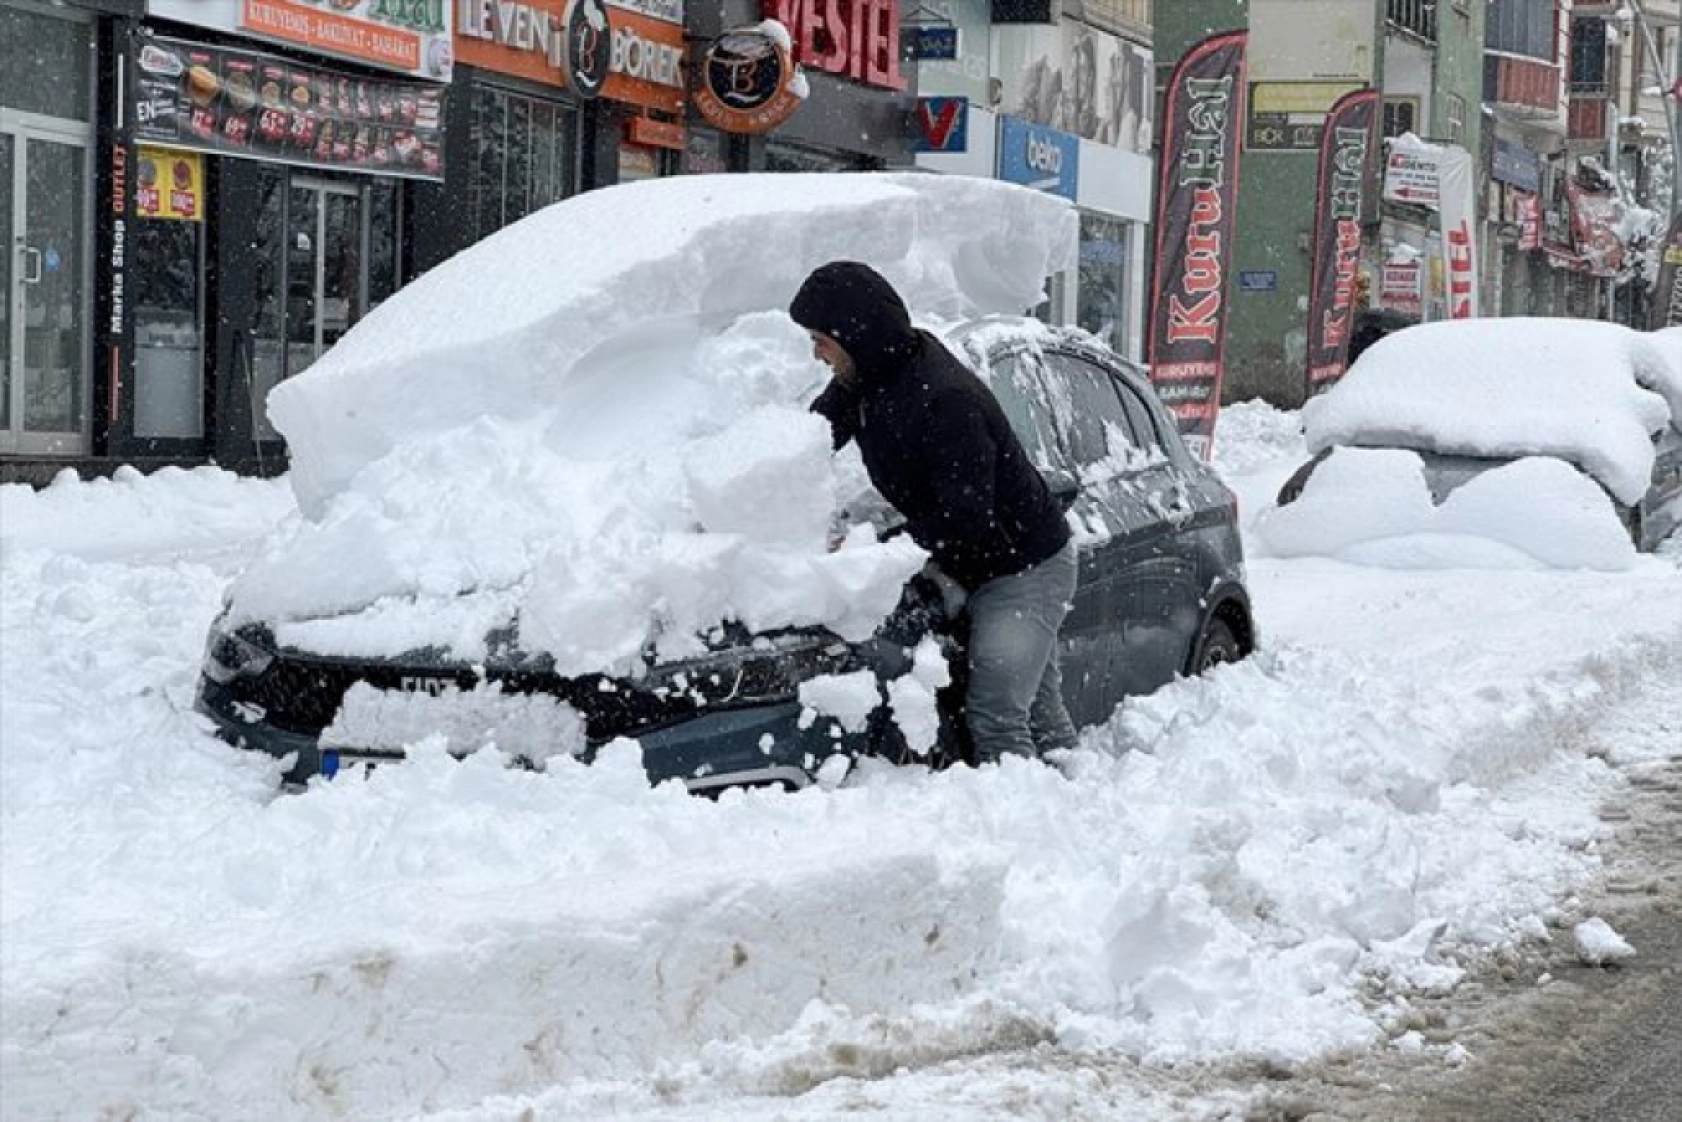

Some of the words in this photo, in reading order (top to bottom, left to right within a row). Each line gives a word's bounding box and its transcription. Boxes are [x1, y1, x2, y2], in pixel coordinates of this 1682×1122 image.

[459, 0, 561, 68] LEVENT
[777, 0, 909, 92] VESTEL
[112, 143, 127, 213] OUTLET
[112, 220, 126, 268] Shop
[111, 273, 124, 334] Marka
